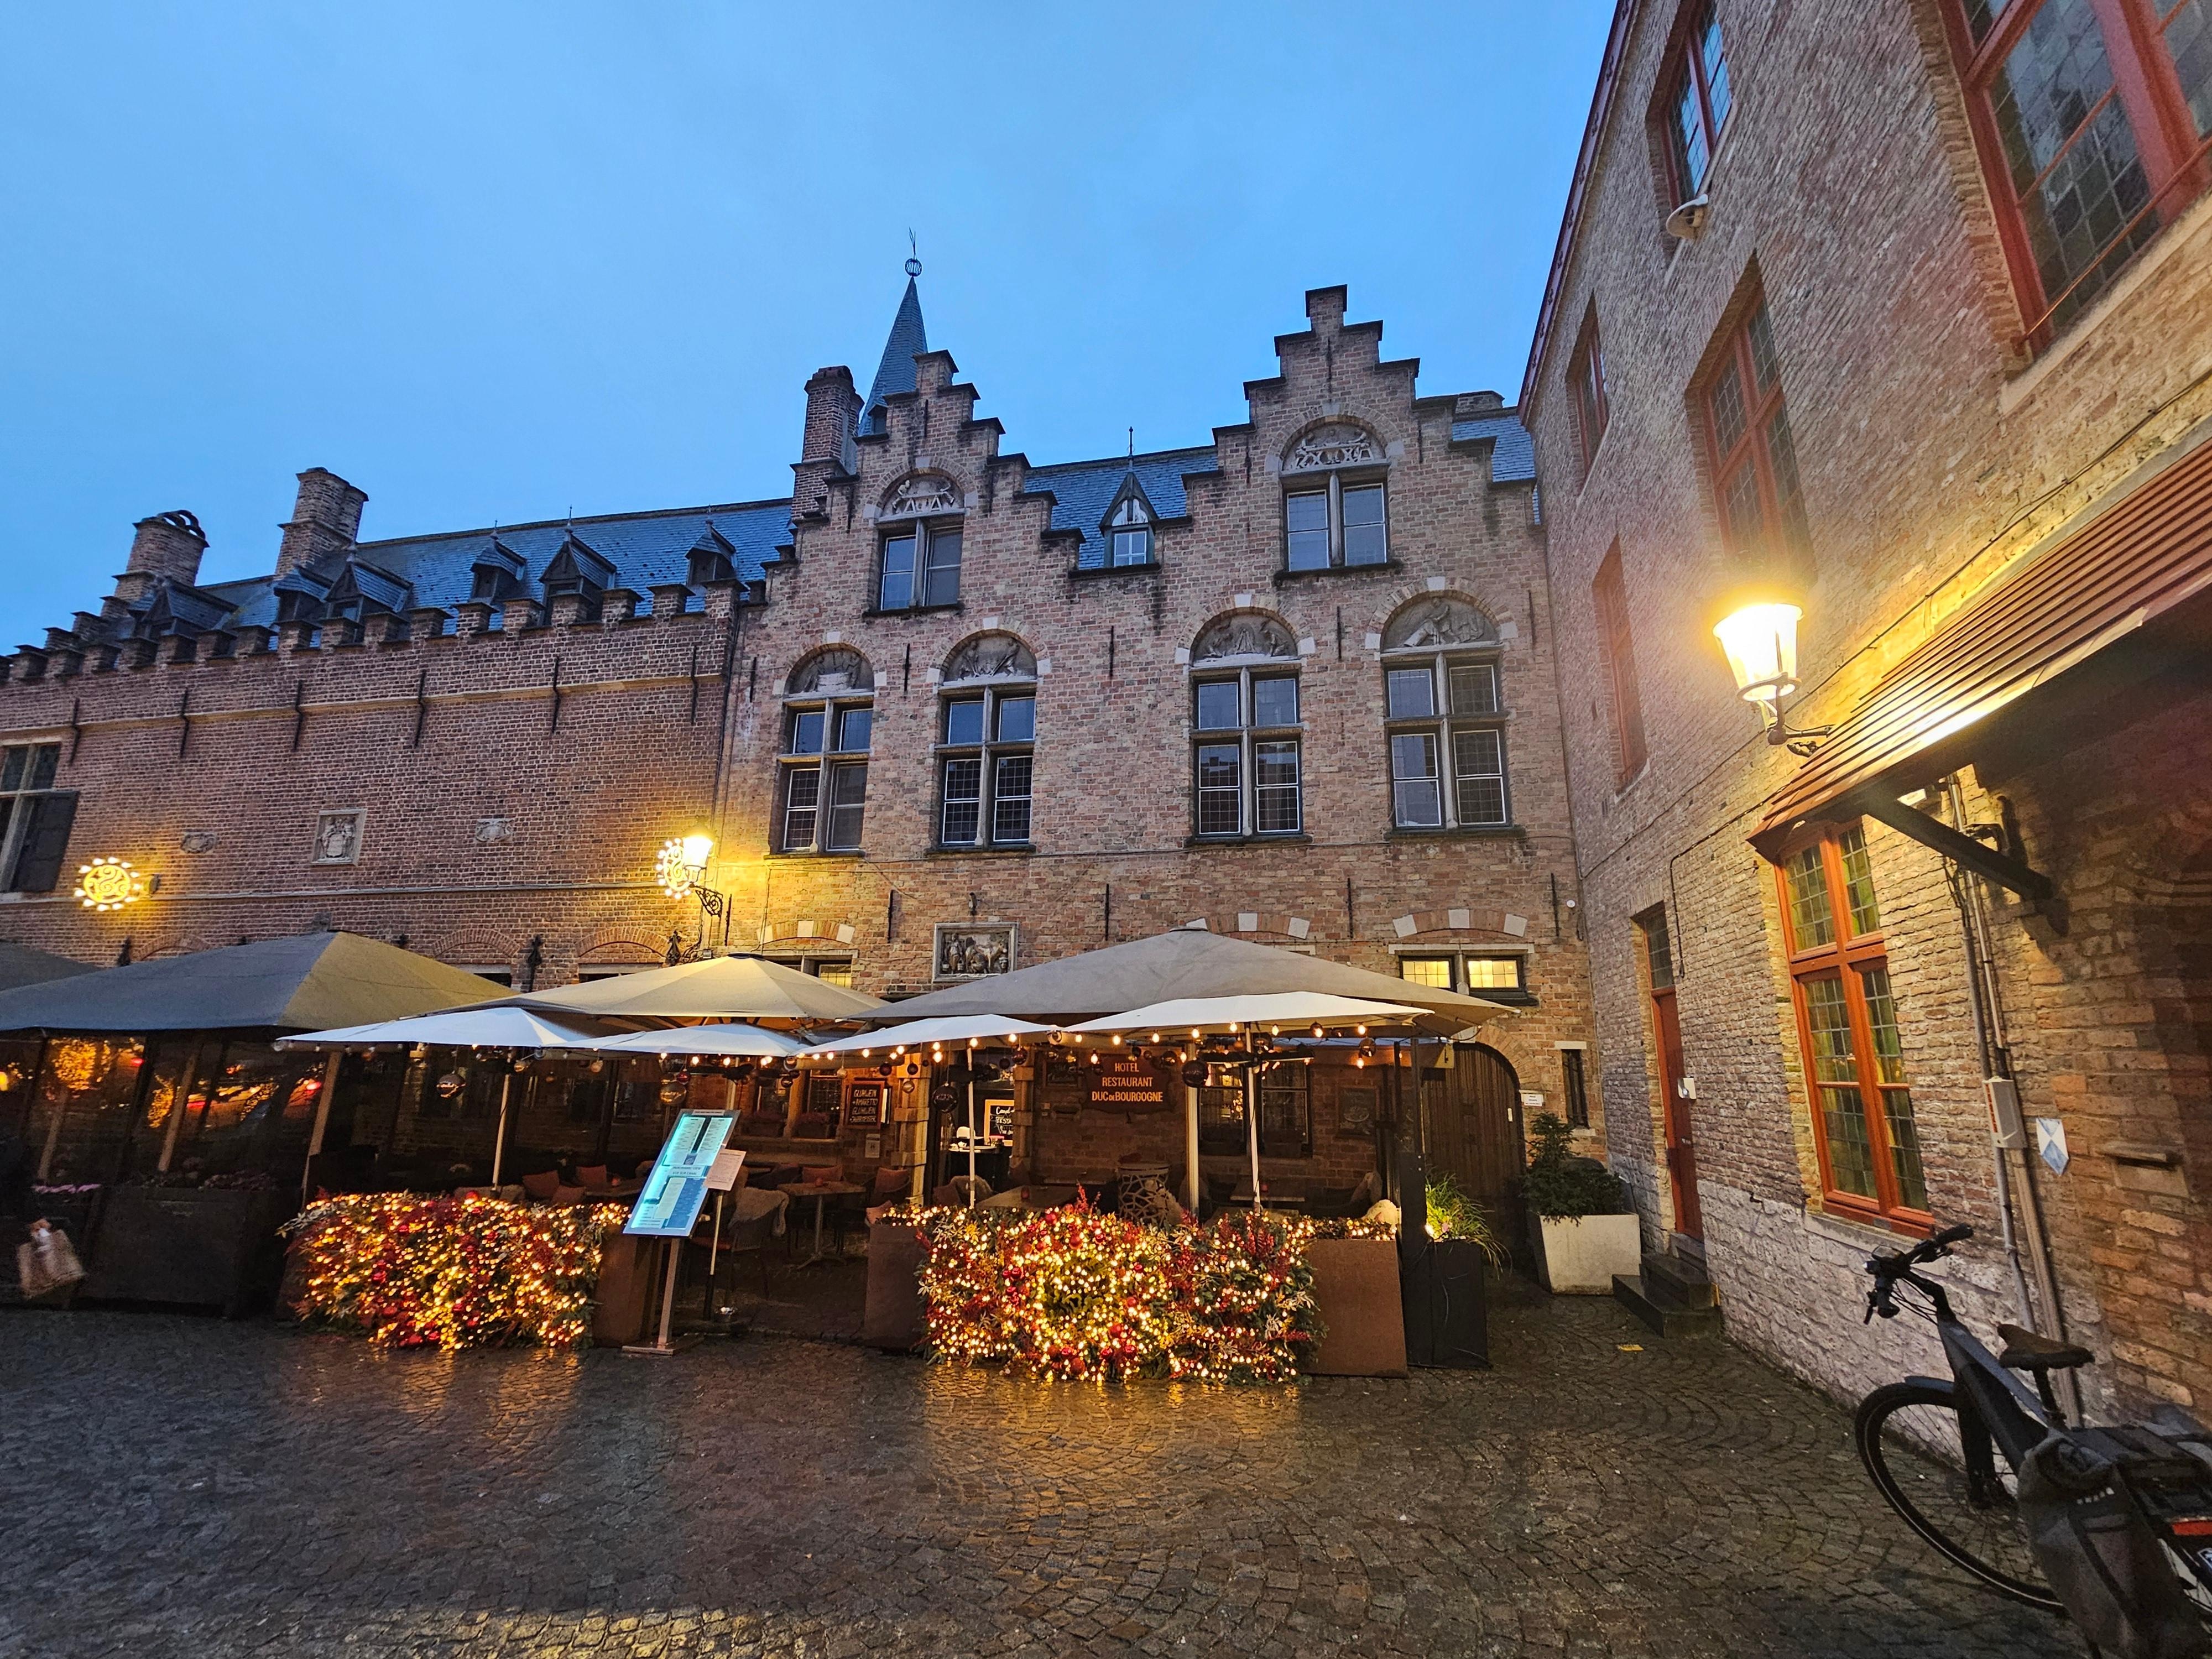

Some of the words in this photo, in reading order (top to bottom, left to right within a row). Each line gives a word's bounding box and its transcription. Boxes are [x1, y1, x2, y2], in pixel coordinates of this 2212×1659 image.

[1115, 1062, 1139, 1072] HOTEL
[1102, 1077, 1153, 1087] RESTAURANT
[1092, 1091, 1108, 1101] DUC
[1115, 1091, 1163, 1102] BOURGOGNE
